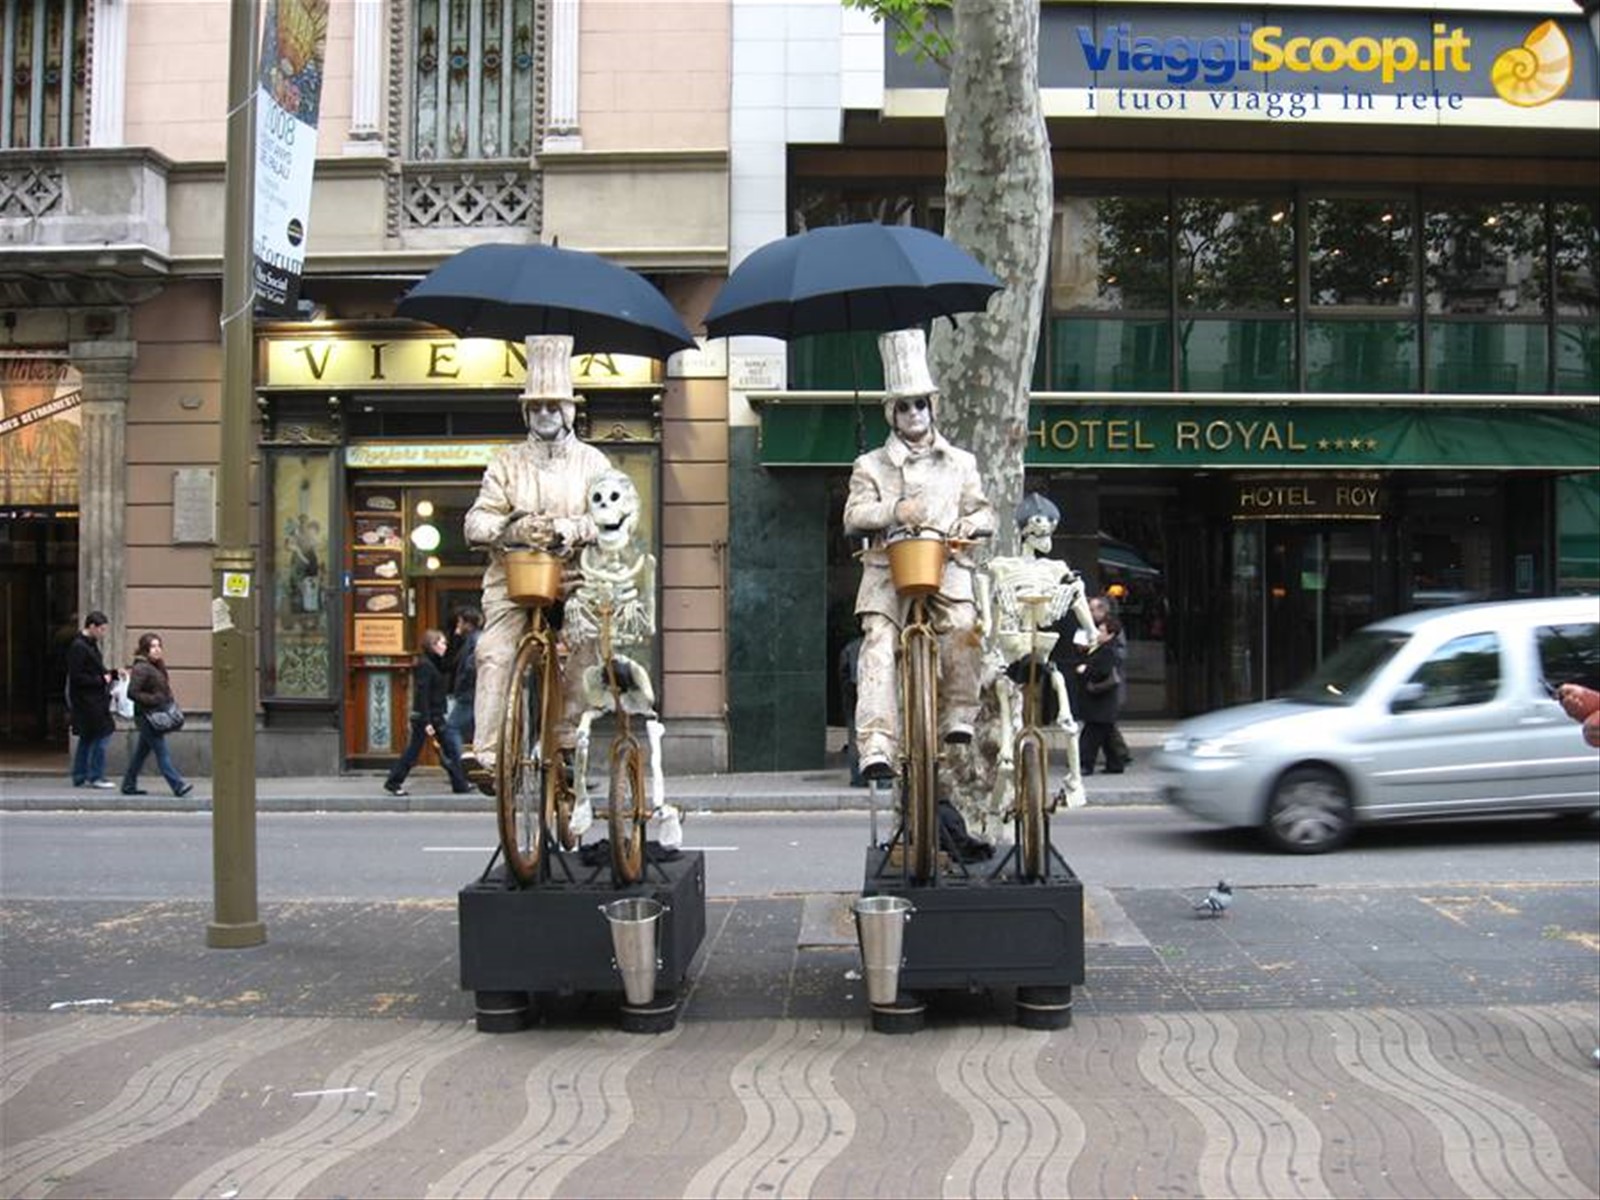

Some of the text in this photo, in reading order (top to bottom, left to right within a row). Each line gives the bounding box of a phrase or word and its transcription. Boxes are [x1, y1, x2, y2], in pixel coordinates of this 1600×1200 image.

[1028, 419, 1308, 451] HOTEL ROYAL
[1241, 486, 1379, 507] HOTEL ROY
